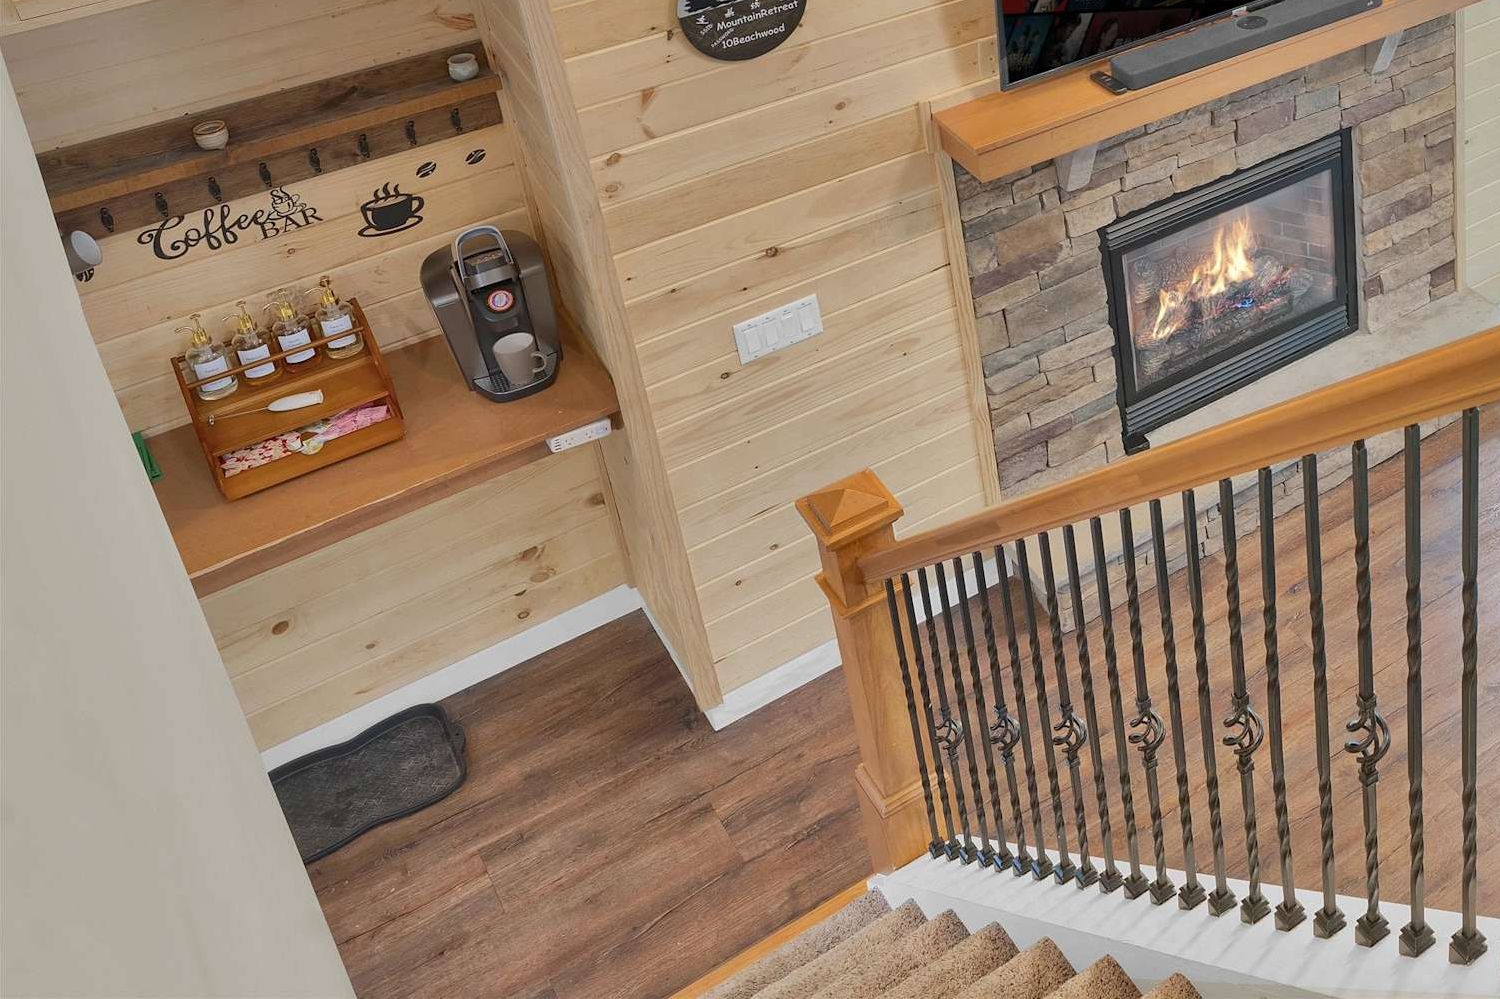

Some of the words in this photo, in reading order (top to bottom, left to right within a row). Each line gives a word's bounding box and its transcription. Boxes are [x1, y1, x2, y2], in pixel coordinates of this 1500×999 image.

[716, 0, 799, 32] MountainRetreat
[721, 23, 786, 50] 10Beachwood
[137, 202, 271, 260] Coffee
[259, 204, 324, 241] BAR
